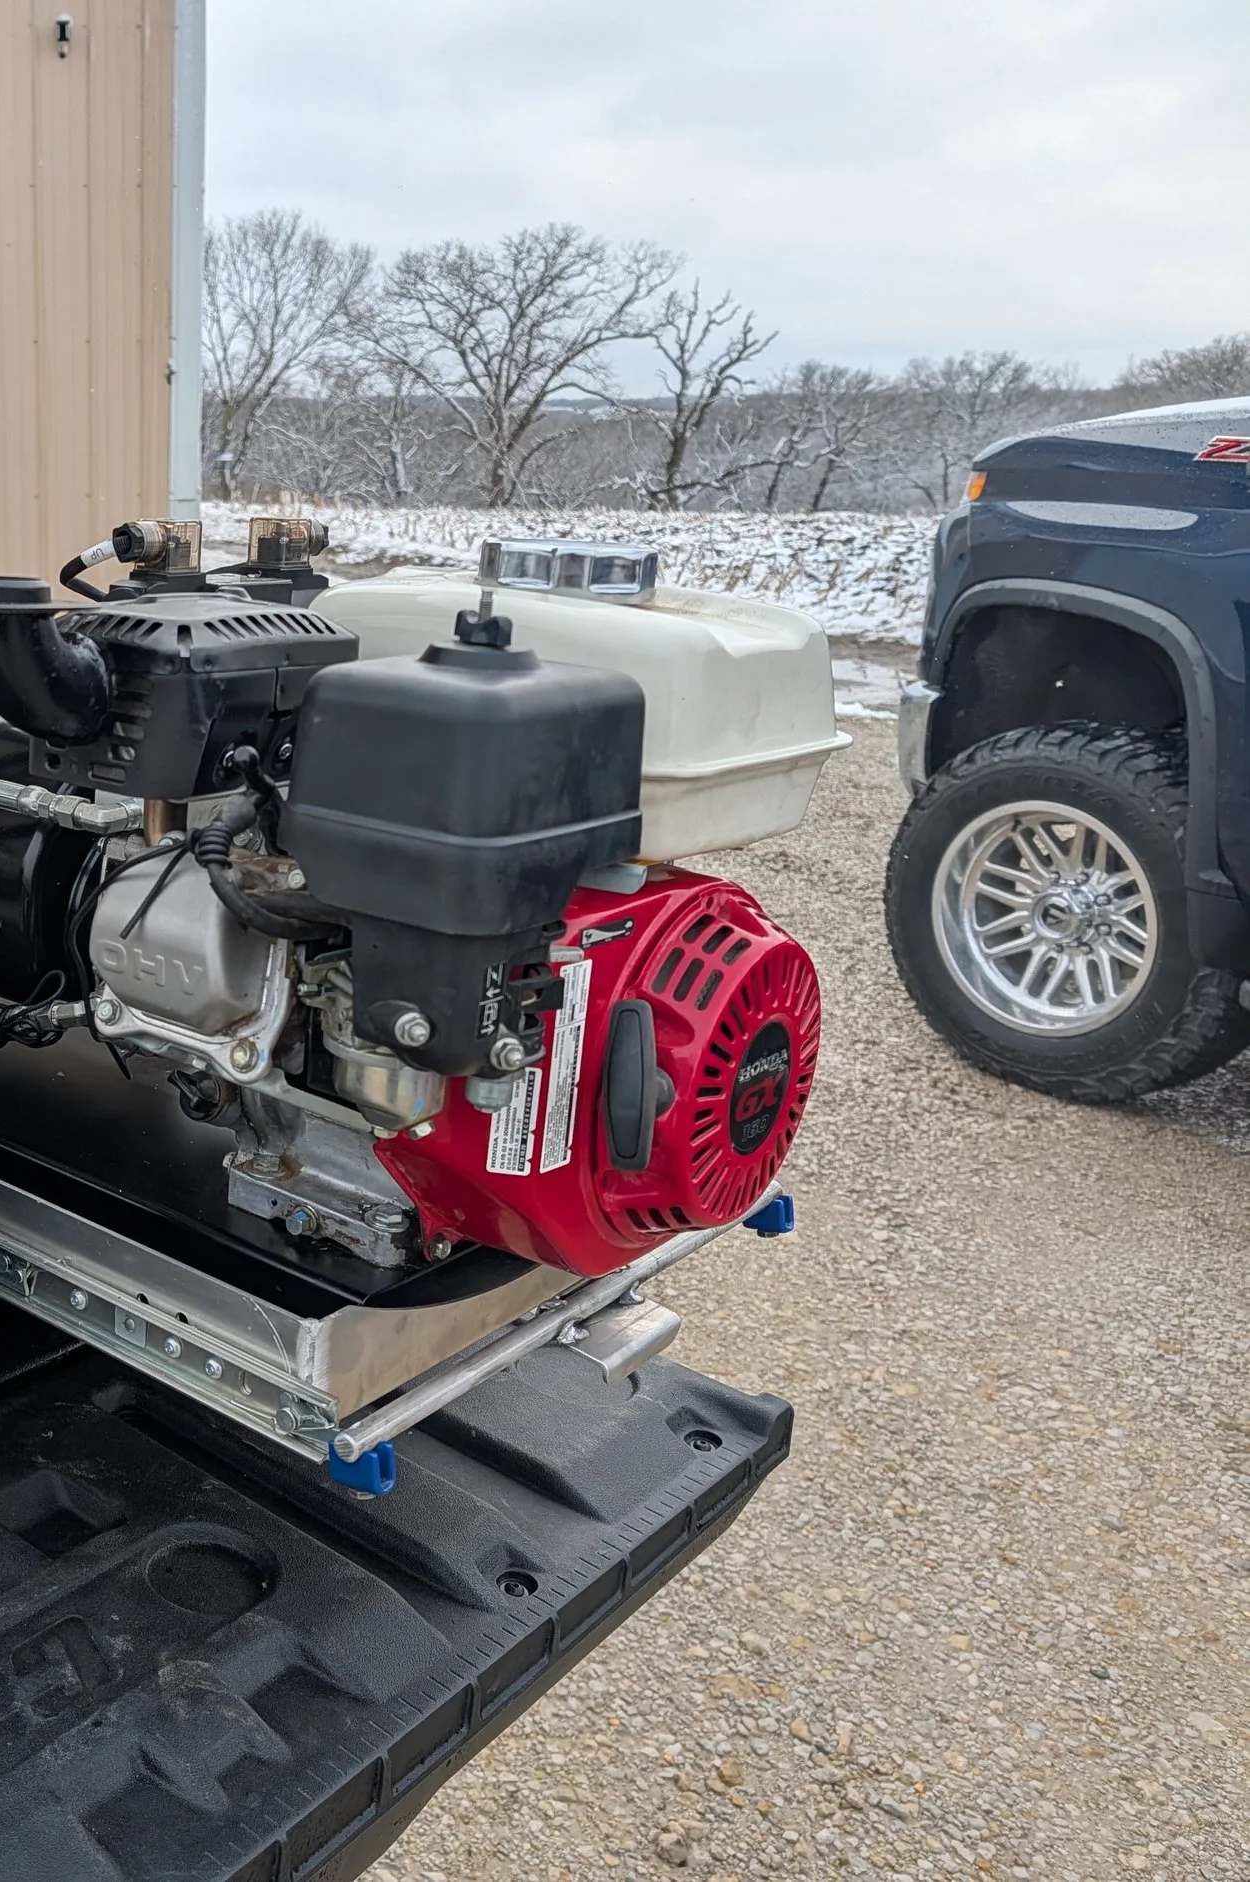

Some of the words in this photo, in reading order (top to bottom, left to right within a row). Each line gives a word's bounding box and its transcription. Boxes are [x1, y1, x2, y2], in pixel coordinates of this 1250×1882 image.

[90, 547, 105, 561] UP
[95, 939, 203, 996] OHV
[738, 1048, 789, 1085] HONDA
[735, 1072, 785, 1122] GX
[741, 1115, 770, 1143] 160
[490, 1136, 499, 1169] HONDA
